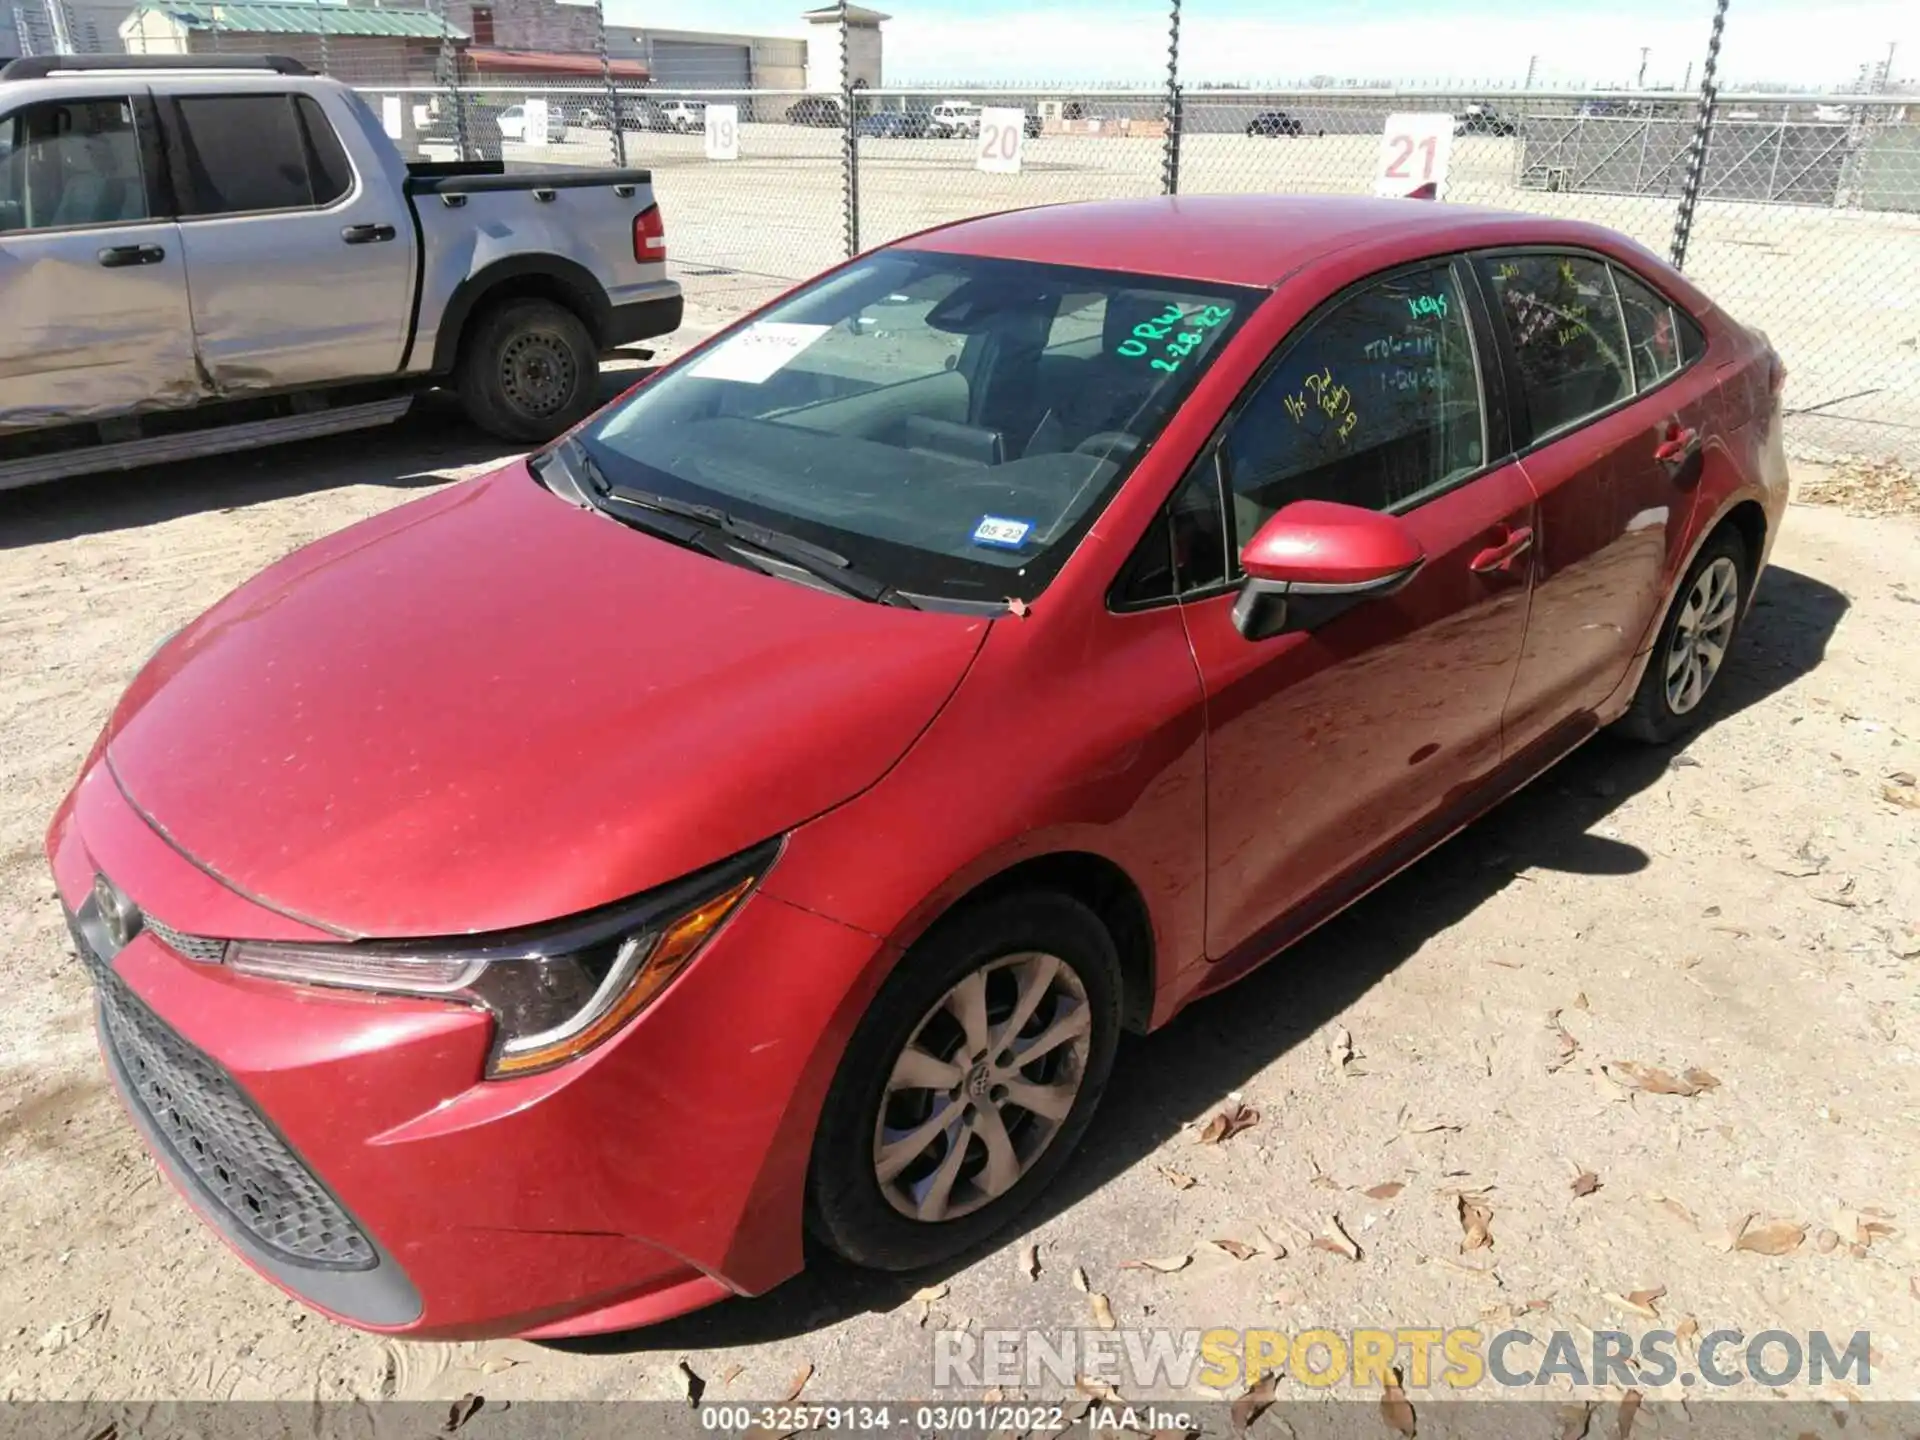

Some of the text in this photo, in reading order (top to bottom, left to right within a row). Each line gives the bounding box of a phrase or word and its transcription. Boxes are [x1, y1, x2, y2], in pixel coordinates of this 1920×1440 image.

[709, 117, 734, 150] 19
[982, 123, 1018, 160] 20
[1384, 134, 1438, 180] 21
